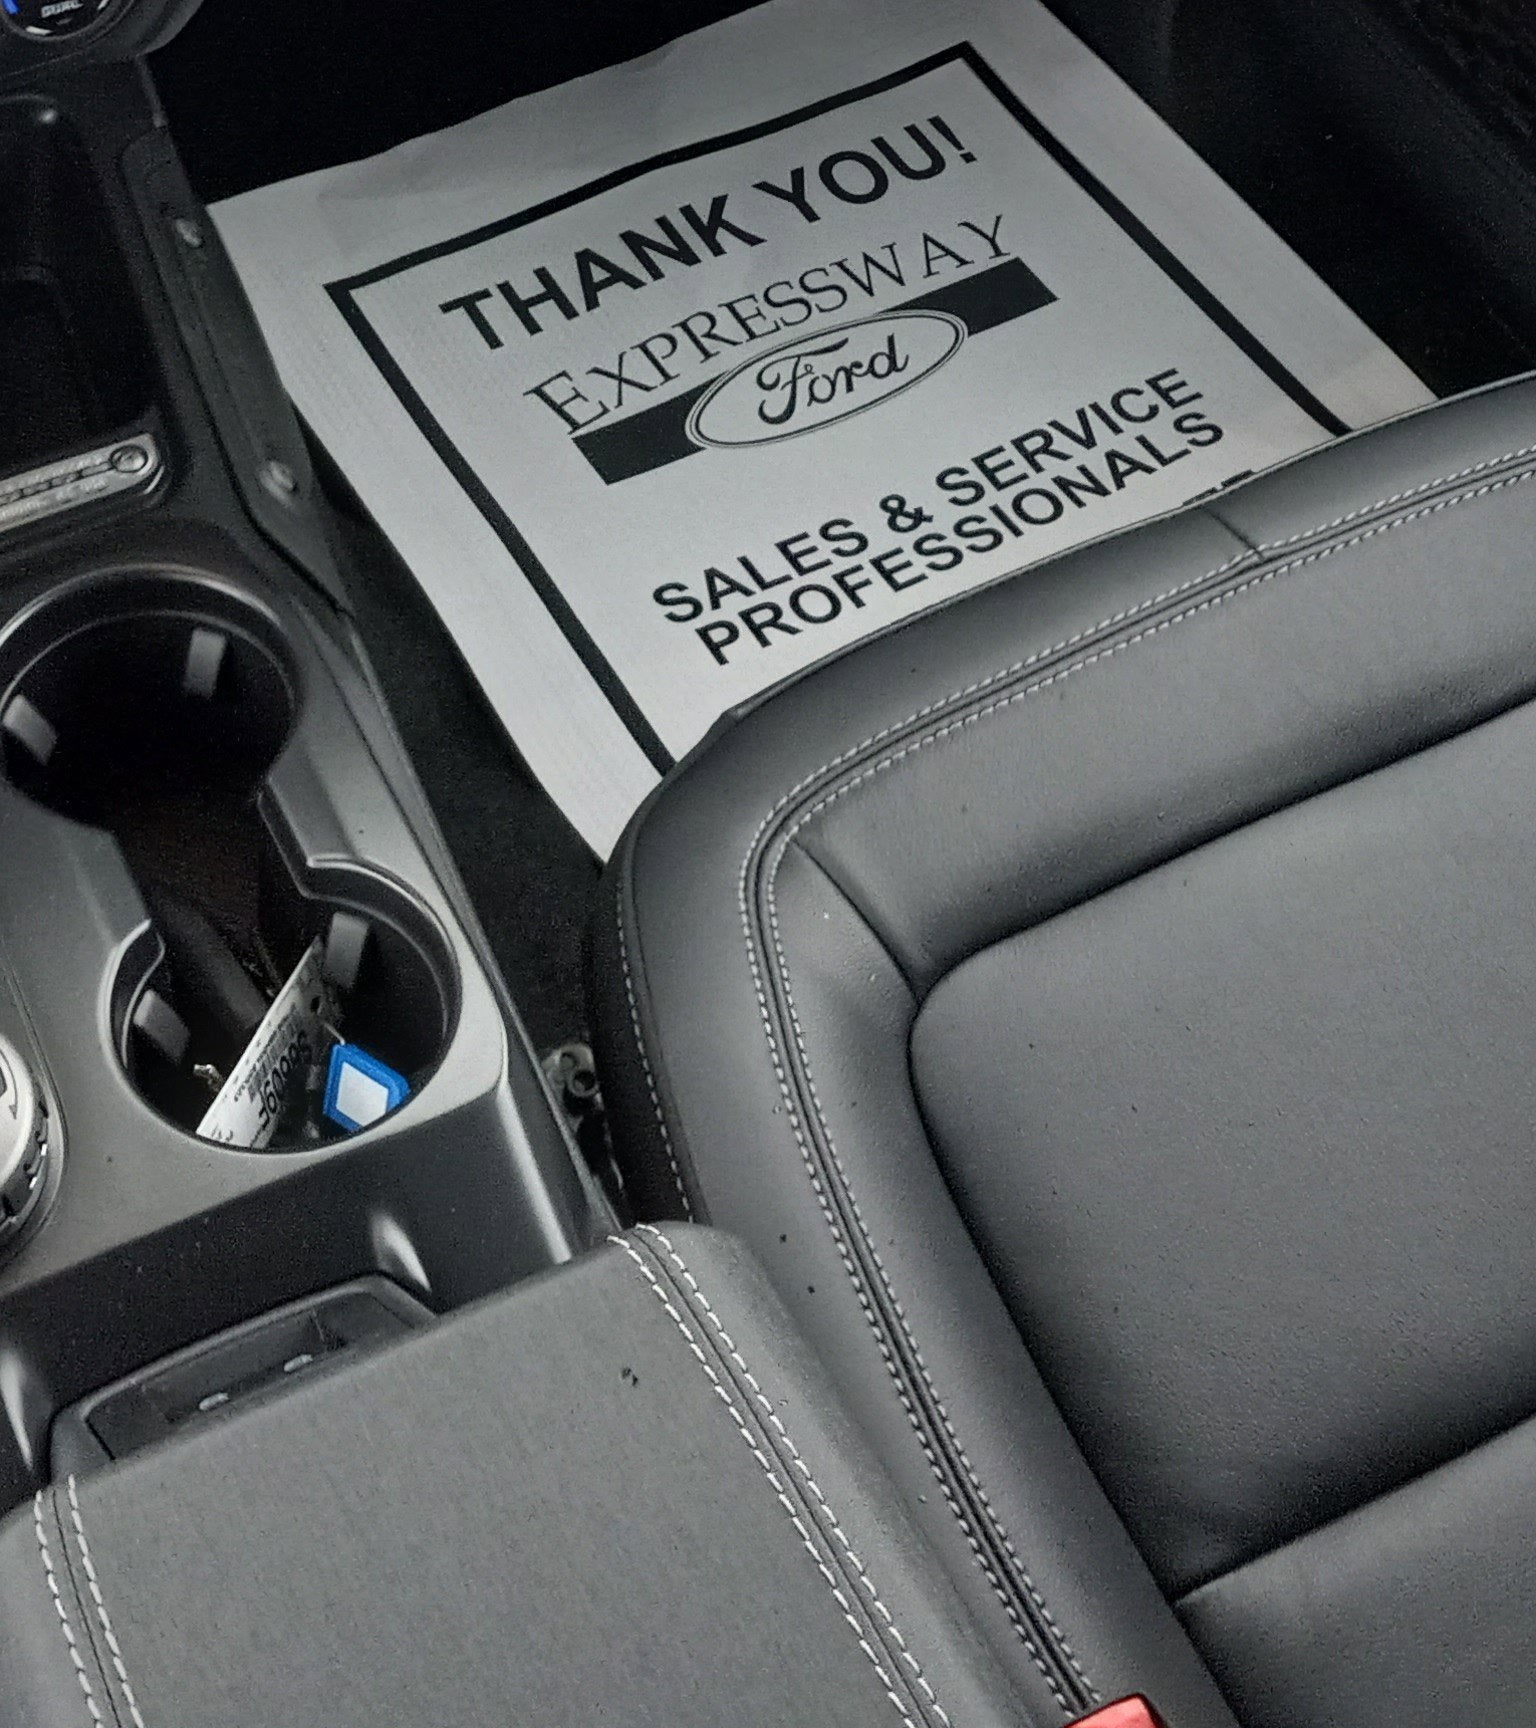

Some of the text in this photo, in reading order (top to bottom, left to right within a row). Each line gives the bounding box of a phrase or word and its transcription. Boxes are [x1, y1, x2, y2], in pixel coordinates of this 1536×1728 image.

[438, 114, 978, 351] THANK YOU!
[523, 214, 1013, 436] EXPRESSWAY
[652, 367, 1204, 624] SALES & SERVICE
[754, 333, 910, 426] Ford
[695, 410, 1225, 666] PROFESSIONALS
